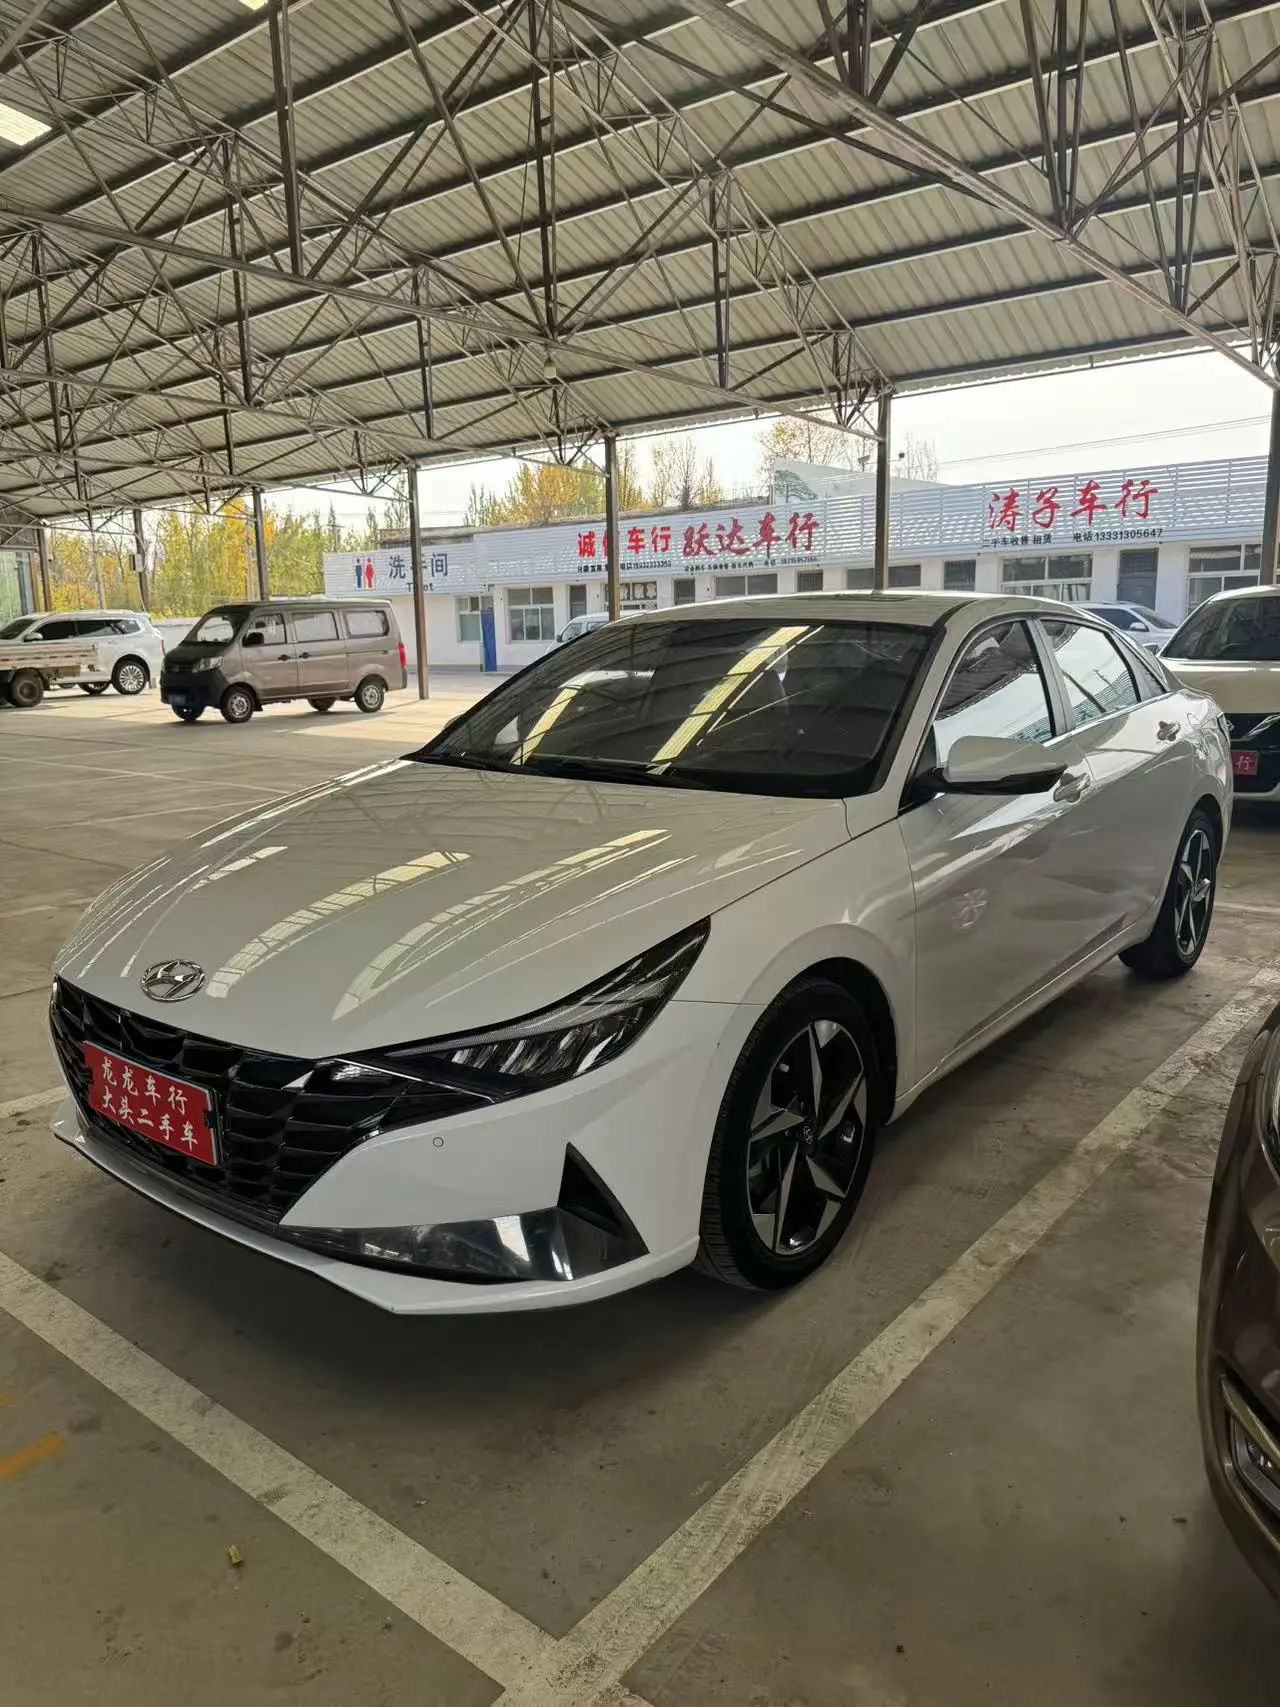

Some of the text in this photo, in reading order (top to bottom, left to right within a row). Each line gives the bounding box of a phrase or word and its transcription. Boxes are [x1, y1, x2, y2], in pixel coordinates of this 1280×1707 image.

[988, 479, 1159, 532] 涛子车行
[683, 511, 820, 559] 跃达车行
[406, 582, 434, 592] Tet
[101, 1056, 188, 1115] 龙龙车行
[102, 1086, 198, 1151] 大头二手车
